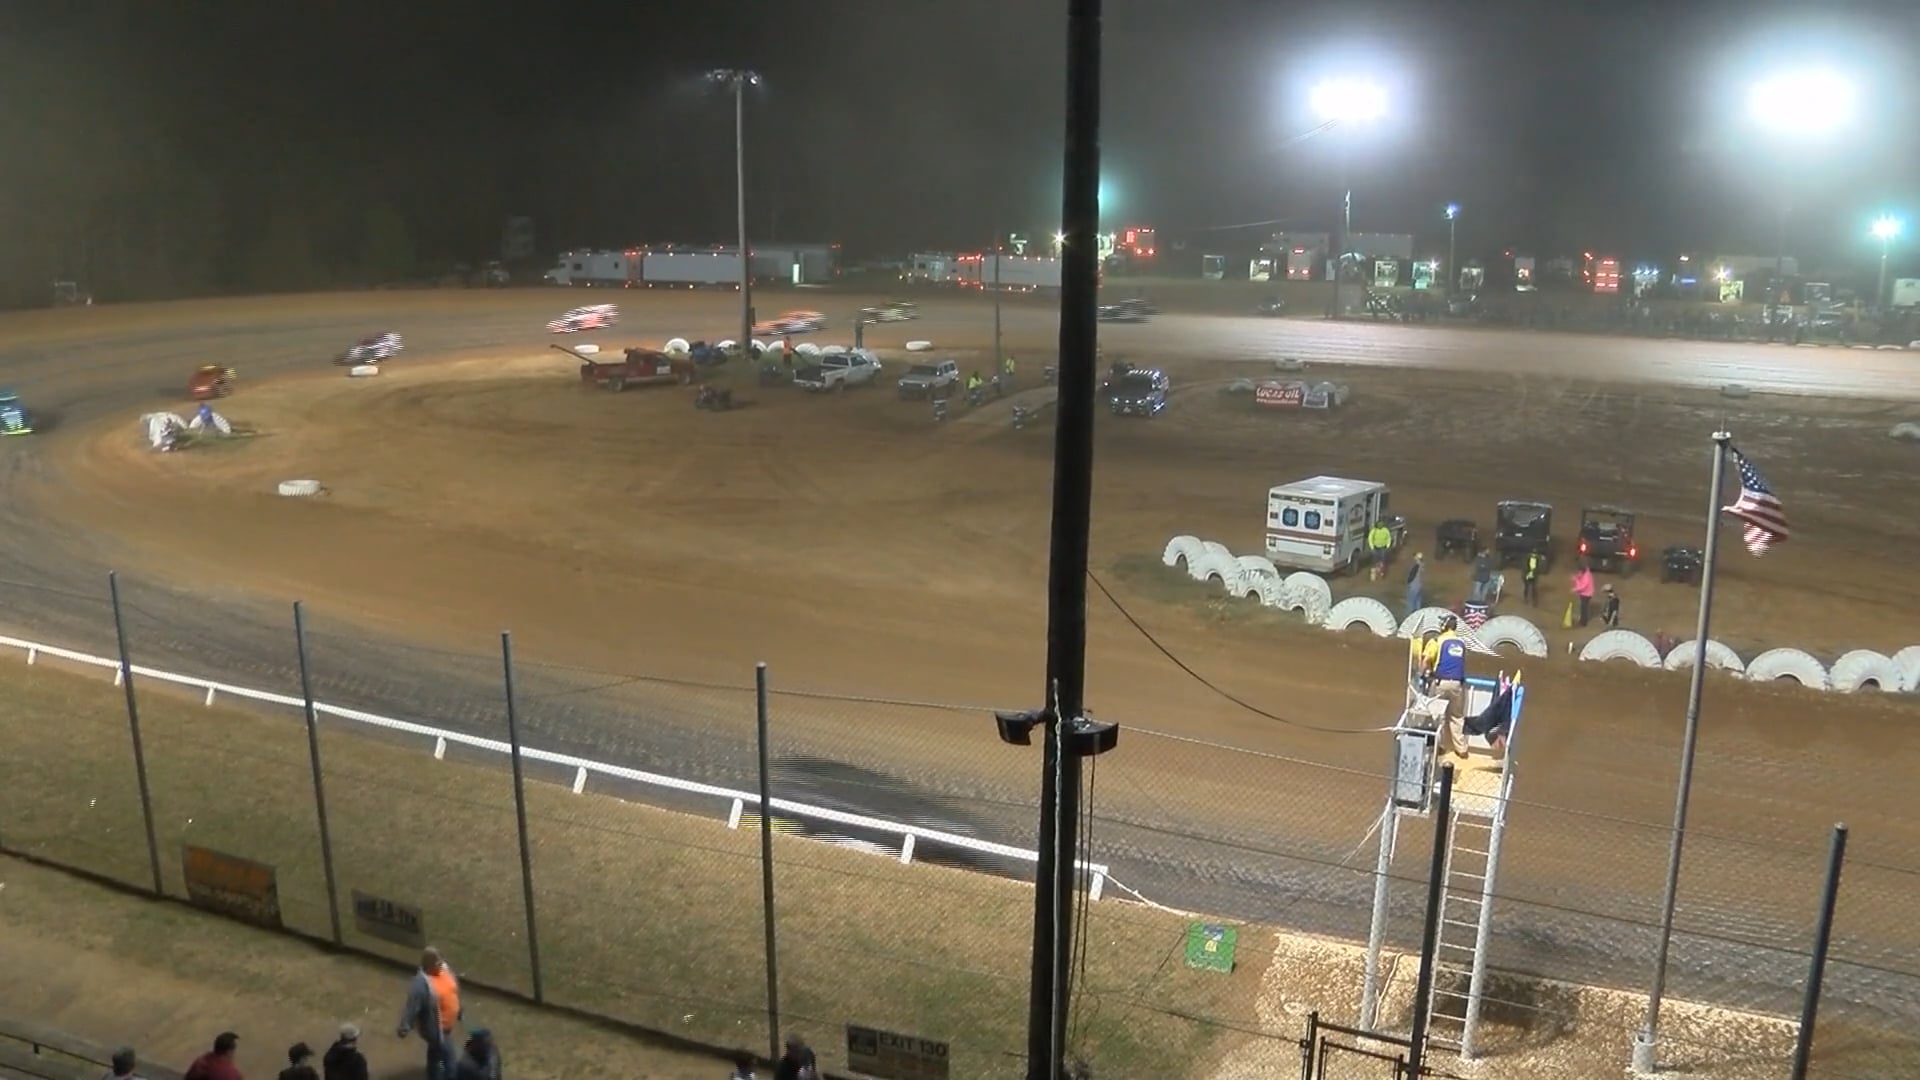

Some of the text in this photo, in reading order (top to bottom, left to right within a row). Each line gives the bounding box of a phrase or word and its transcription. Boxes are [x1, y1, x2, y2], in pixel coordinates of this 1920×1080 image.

[1256, 387, 1300, 399] LUCAS OIL
[880, 1032, 915, 1050] EXIT
[920, 1040, 947, 1057] 130
